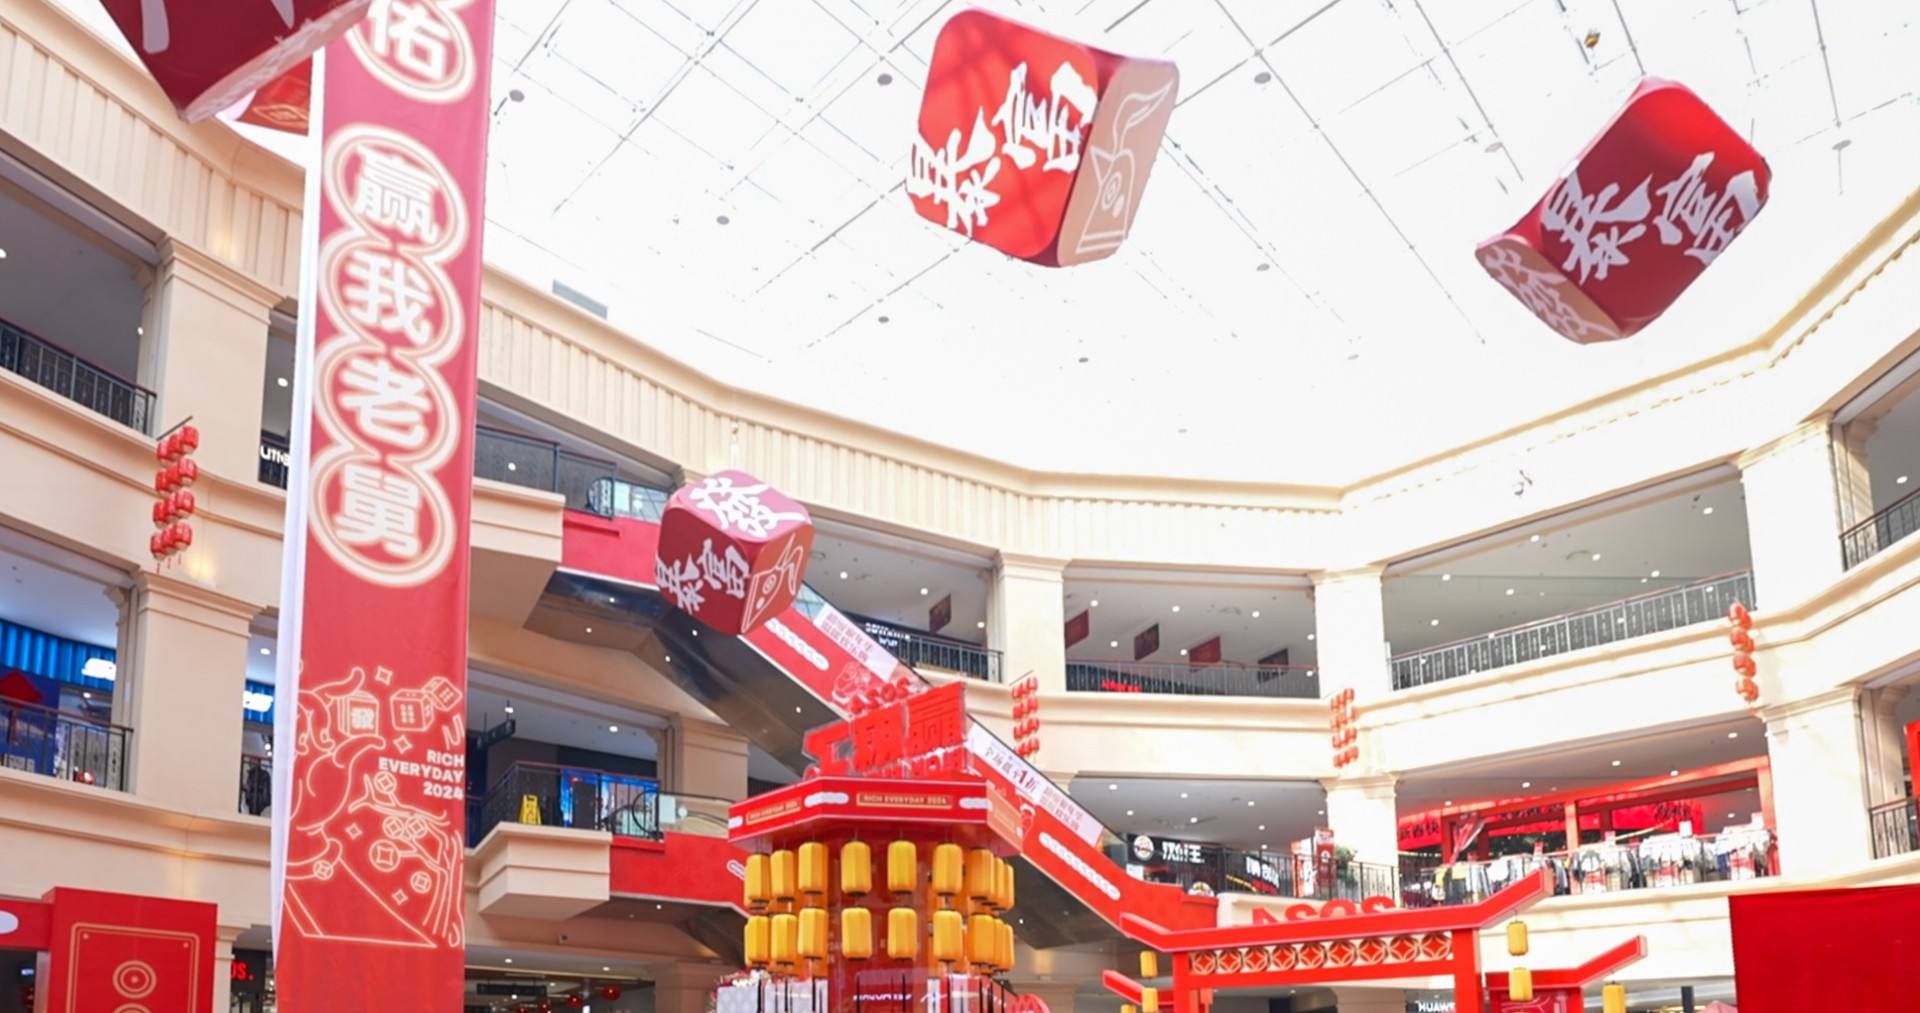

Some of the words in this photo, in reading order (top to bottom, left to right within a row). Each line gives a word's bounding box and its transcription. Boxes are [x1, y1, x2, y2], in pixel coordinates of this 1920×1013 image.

[366, 0, 449, 80] 佑
[334, 144, 442, 558] 赢我老舅
[379, 757, 463, 781] EVERYDAY
[427, 750, 464, 767] RICH
[423, 781, 463, 800] 2024
